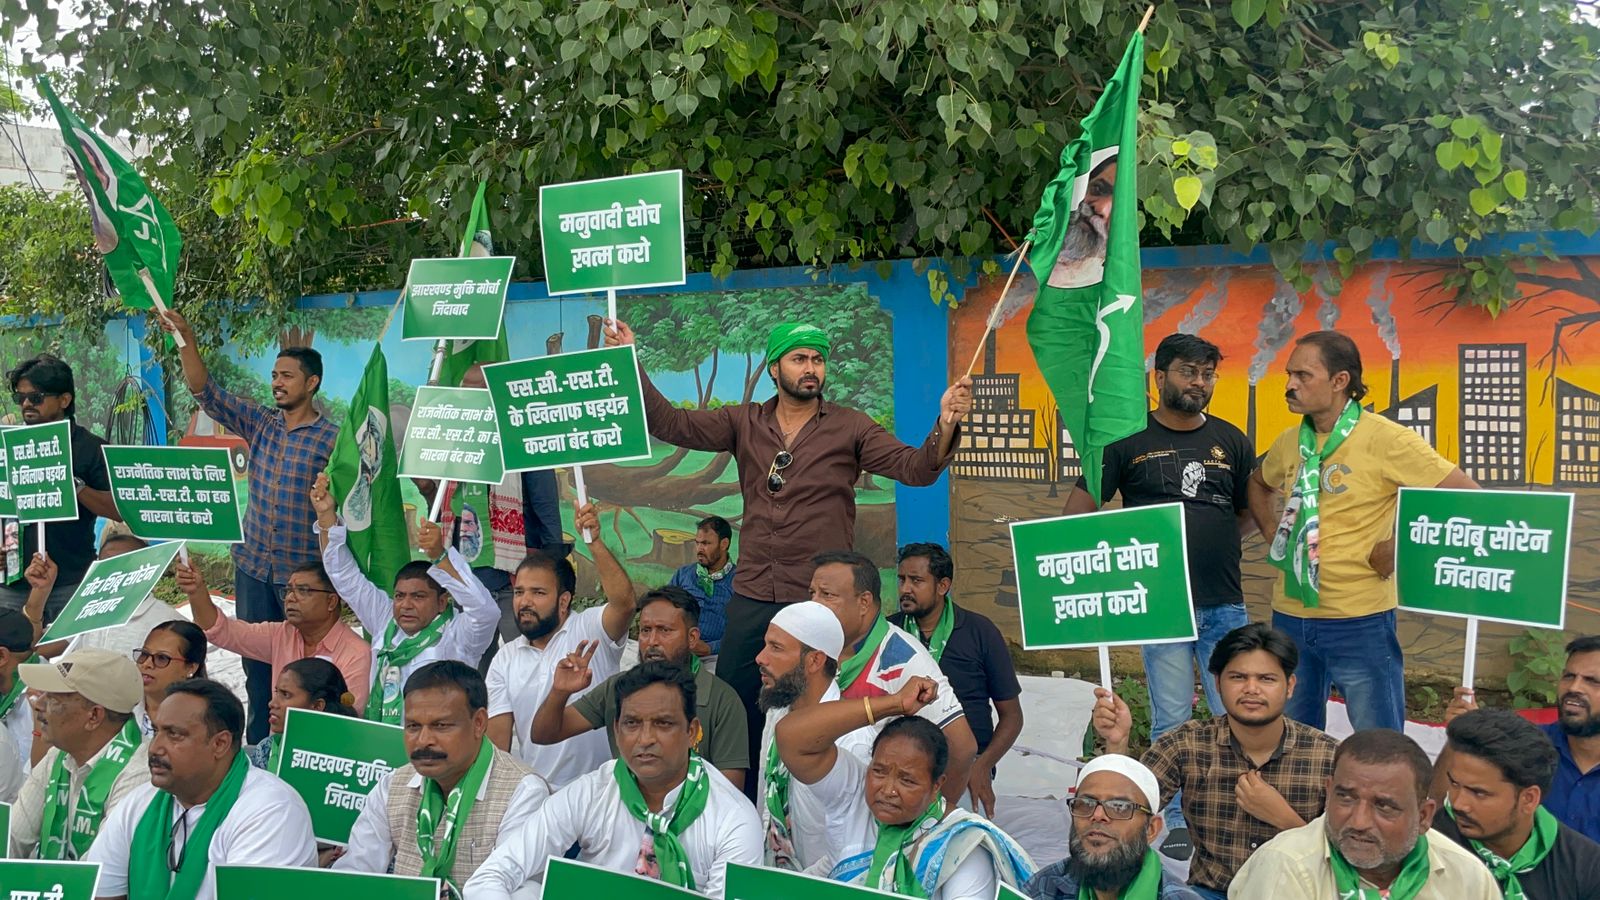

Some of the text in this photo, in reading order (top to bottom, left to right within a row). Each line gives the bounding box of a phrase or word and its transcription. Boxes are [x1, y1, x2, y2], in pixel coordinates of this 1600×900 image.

[558, 199, 662, 239] मनुवादी सोच
[616, 235, 651, 264] करो
[411, 278, 502, 300] झारखण्ड मुक्ति मोर्चा
[431, 299, 470, 317] जिंदाबाद
[506, 363, 619, 399] एस.सी.-एस.टी.
[417, 403, 495, 422] राजनैतिक लाभ के
[507, 392, 629, 428] के खिलाफ षड़यंत्र
[12, 434, 63, 461] एस.सी.-एस.टी.
[410, 424, 500, 445] एस.सी.-एस.टी. का ह
[523, 421, 622, 455] करना बंद करो
[419, 447, 485, 465] मारना बंद करो
[11, 460, 67, 487] के खिलाफ षड़यंत्र
[113, 462, 227, 482] राजनैतिक लाभ के लिए
[16, 493, 36, 510] करना
[35, 488, 47, 509] बंद
[46, 486, 63, 508] करो
[117, 484, 231, 504] एस.सी.-एस.टी. का हक
[139, 507, 214, 526] मारना बंद करो
[1409, 514, 1552, 557] वीर शिबू सोरेन
[1035, 537, 1160, 585] मनुवादी सोच
[1433, 556, 1516, 593] जिंदाबाद
[80, 562, 161, 597] वीर शिबू सोरेन
[74, 596, 125, 621] जिंदाबाद
[1104, 580, 1148, 616] करो
[290, 748, 356, 777] झारखण्ड
[323, 781, 368, 811] जिंदाब
